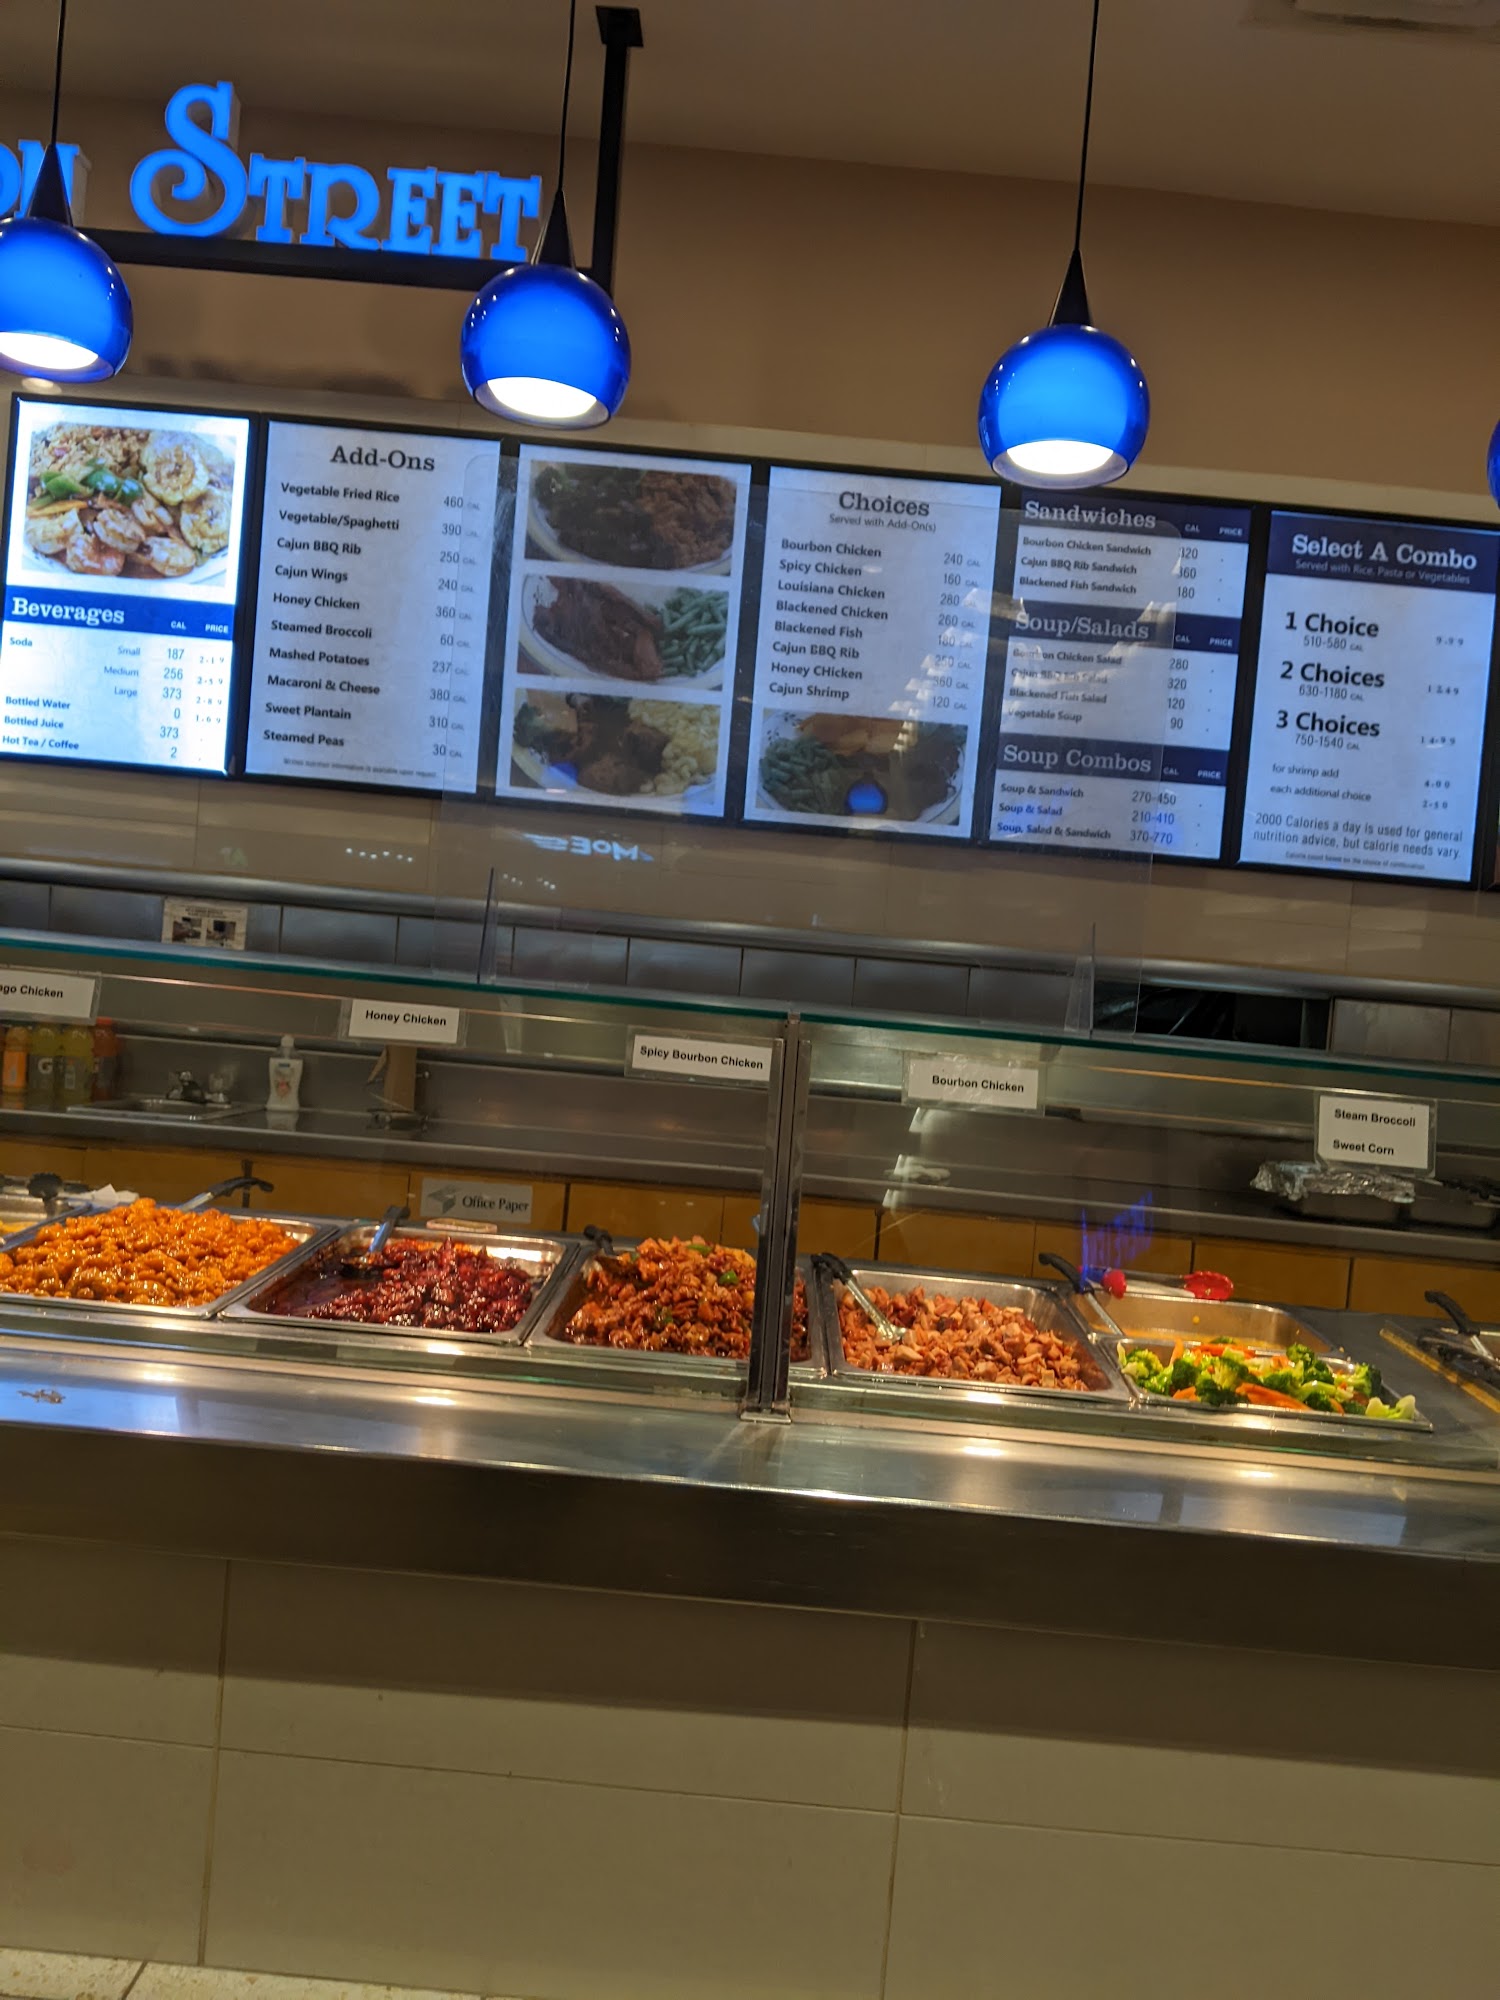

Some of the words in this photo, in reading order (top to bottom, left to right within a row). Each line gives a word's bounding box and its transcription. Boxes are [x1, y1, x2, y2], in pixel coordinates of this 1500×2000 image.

[130, 81, 541, 262] STREET
[330, 446, 435, 471] Add-Ons
[281, 483, 339, 497] Vegetable
[343, 488, 371, 500] Fried
[376, 491, 400, 502] Rice
[443, 496, 463, 507] 460
[839, 491, 930, 516] Choices
[279, 511, 399, 532] Vegetable/Spaghetti
[442, 524, 461, 535] 390
[829, 514, 861, 525] Served
[865, 517, 884, 527] with
[887, 519, 936, 533] Add-On(s)
[1024, 500, 1157, 529] Sandwiches
[277, 538, 309, 551] Cajun
[314, 541, 338, 555] BBQ
[342, 544, 361, 555] Rib
[440, 552, 459, 563] 250
[781, 539, 831, 553] Bourbon
[836, 543, 881, 557] Chicken
[944, 553, 963, 565] 240
[1023, 537, 1064, 549] Bourbon
[1067, 540, 1104, 552] Chicken
[1106, 544, 1151, 555] Sandwich
[1292, 534, 1363, 559] Select
[1369, 542, 1388, 561] A
[1396, 544, 1477, 569] Combo
[779, 559, 810, 574] Spicy
[815, 563, 862, 576] Chicken
[944, 574, 961, 585] 160
[1021, 557, 1048, 568] Cajun
[1051, 558, 1071, 570] BBQ
[1074, 561, 1089, 570] Rib
[1092, 562, 1137, 574] Sandwich
[275, 565, 307, 578] Cajun
[312, 568, 347, 582] Wings
[438, 579, 457, 591] 240
[1020, 576, 1068, 588] Blackened
[1071, 580, 1089, 590] Fish
[1092, 582, 1136, 594] Sandwich
[1418, 571, 1470, 585] Vegetables
[778, 581, 833, 595] Louisiana
[838, 585, 885, 599] Chicken
[940, 594, 959, 605] 280
[12, 597, 124, 626] Beverages
[205, 624, 228, 633] PRICE
[273, 593, 310, 607] Honey
[314, 596, 360, 609] Chicken
[436, 606, 455, 618] 360
[776, 601, 837, 616] Blackened
[841, 607, 888, 620] Chicken
[938, 614, 958, 626] 260
[271, 620, 322, 634] Steamed
[326, 626, 372, 638] Broccoli
[440, 635, 454, 646] 60
[774, 621, 835, 636] Blackened
[840, 627, 862, 638] Fish
[1015, 613, 1150, 639] Soup/Salads
[1286, 612, 1297, 630] 1
[1305, 613, 1379, 637] Choice
[9, 637, 33, 646] Soda
[168, 648, 184, 660] 187
[772, 641, 806, 654] Cajun
[810, 645, 836, 658] BBQ
[840, 648, 859, 659] Rib
[1303, 635, 1346, 649] 510-580
[269, 648, 315, 661] Mashed
[319, 653, 369, 666] Potatoes
[432, 661, 451, 673] 237
[771, 662, 809, 677] Honey
[814, 666, 862, 679] CHicken
[1057, 651, 1094, 662] Chicken
[1097, 655, 1122, 665] Salad
[1169, 658, 1188, 670] 280
[104, 667, 139, 676] Medium
[163, 668, 183, 679] 256
[1168, 678, 1186, 690] 320
[1280, 661, 1293, 680] 2
[1300, 663, 1385, 687] Choices
[114, 687, 137, 697] Large
[162, 688, 182, 699] 373
[268, 675, 321, 689] Macaroni
[339, 680, 380, 694] Cheese
[430, 689, 449, 700] 380
[769, 683, 802, 695] Cajun
[806, 685, 849, 701] Shrimp
[1299, 685, 1347, 699] 630-1180
[5, 696, 40, 707] Bottled
[42, 699, 70, 709] Water
[1009, 688, 1058, 700] Blackened
[1082, 693, 1107, 704] Salad
[1168, 698, 1185, 710] 120
[265, 703, 300, 715] Sweet
[304, 705, 351, 719] Plantain
[429, 717, 447, 728] 310
[1058, 711, 1082, 722] Soup
[1276, 710, 1288, 729] 3
[1296, 712, 1380, 737] Choices
[4, 716, 38, 726] Bottled
[41, 718, 64, 728] Juice
[160, 727, 179, 738] 373
[2, 736, 20, 744] Hot
[23, 737, 38, 746] Tea
[49, 740, 79, 750] Coffee
[263, 730, 314, 744] Steamed
[318, 735, 344, 746] Peas
[433, 745, 446, 756] 30
[1295, 734, 1344, 748] 750-1540
[1003, 744, 1058, 769] Soup
[1066, 748, 1151, 773] Combos
[1272, 764, 1284, 773] for
[1287, 766, 1319, 777] shrimp
[1321, 768, 1339, 778] add
[1001, 783, 1025, 795] Soup
[1039, 786, 1084, 798] Sandwich
[1131, 791, 1176, 805] 270-450
[1270, 785, 1292, 794] each
[1294, 788, 1339, 798] additional
[1342, 790, 1371, 801] choice
[999, 803, 1023, 814] Soup
[1037, 805, 1062, 816] Salad
[1131, 811, 1174, 825] 210-410
[1027, 824, 1052, 835] Salad
[1066, 827, 1111, 839] Sandwich
[1255, 813, 1282, 826] 2000
[1286, 816, 1329, 830] Calories
[1343, 820, 1360, 835] day
[1378, 824, 1402, 836] used
[1406, 826, 1420, 837] for
[1424, 827, 1463, 842] general
[1253, 831, 1298, 844] nutrition
[1302, 834, 1339, 848] advice,
[1343, 838, 1360, 848] but
[1364, 839, 1399, 853] calorie
[1403, 843, 1433, 856] needs
[20, 985, 63, 998] Chicken
[366, 1010, 400, 1024] Honey
[403, 1013, 446, 1025] Chicken
[641, 1045, 669, 1060] Spicy
[673, 1050, 717, 1064] Bourbon
[721, 1056, 763, 1069] Chicken
[932, 1075, 978, 1088] Bourbon
[982, 1080, 1024, 1092] Chicken
[1335, 1109, 1367, 1122] Steam
[1371, 1113, 1415, 1127] Broccoli
[1333, 1139, 1365, 1152] Sweet
[1368, 1143, 1394, 1155] Corn
[462, 1196, 495, 1209] Office
[500, 1199, 528, 1213] Paper
